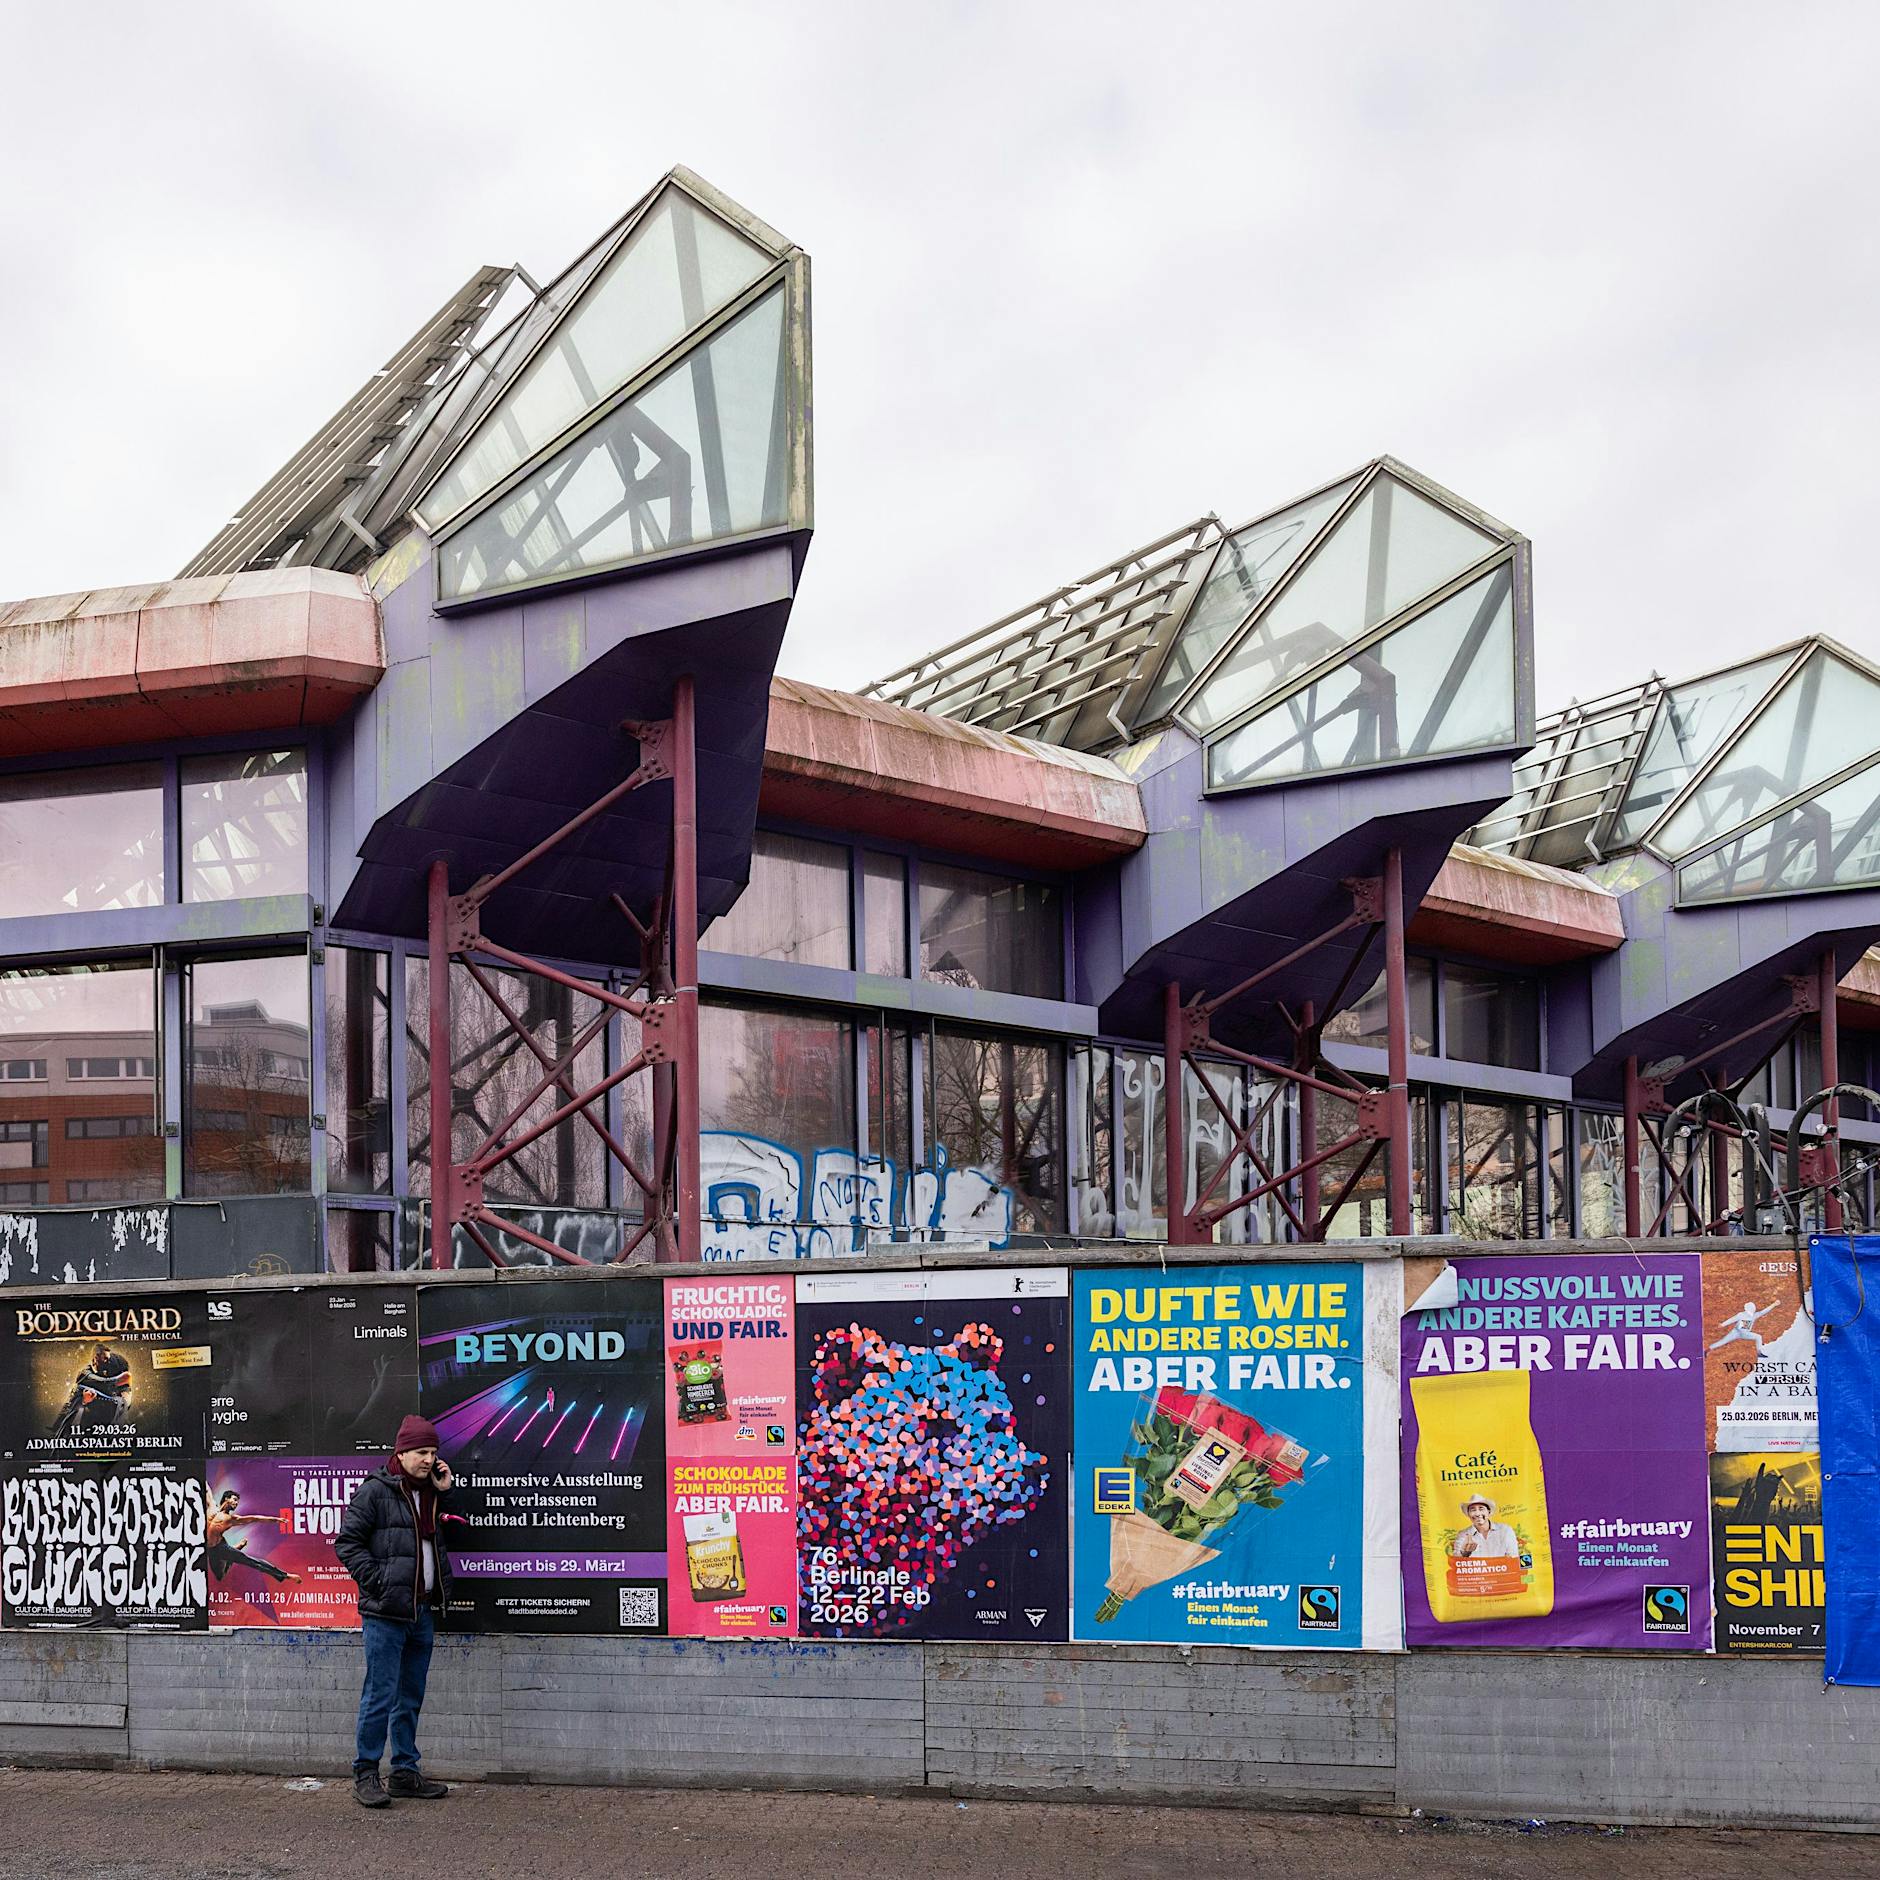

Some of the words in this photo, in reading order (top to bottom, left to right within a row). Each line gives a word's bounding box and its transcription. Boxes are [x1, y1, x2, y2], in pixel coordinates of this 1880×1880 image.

[1759, 1262, 1798, 1273] dEUS
[1621, 1274, 1684, 1298] WIE
[671, 1285, 787, 1306] FRUCHTIG,
[1090, 1285, 1241, 1323] DUFTE
[1250, 1283, 1347, 1319] WIE
[34, 1303, 52, 1311] THE
[384, 1308, 407, 1316] Berghain
[671, 1305, 787, 1321] SCHOKOLADIG.
[16, 1307, 182, 1335] BODYGUARD
[1417, 1306, 1542, 1331] ANDERE
[1547, 1303, 1688, 1329] KAFFEES.
[121, 1333, 139, 1341] THE
[141, 1332, 182, 1341] MUSICAL
[354, 1325, 408, 1339] Liminals
[672, 1321, 723, 1340] UND
[729, 1320, 788, 1339] FAIR.
[1089, 1326, 1221, 1352] ANDERE
[1228, 1324, 1349, 1350] ROSEN.
[455, 1331, 625, 1364] BEYOND
[1416, 1334, 1553, 1373] ABER
[1563, 1333, 1691, 1371] FAIR.
[1088, 1356, 1217, 1392] ABER
[1228, 1354, 1351, 1390] FAIR.
[1722, 1362, 1789, 1373] WORST
[1756, 1375, 1810, 1384] VERSUS
[1739, 1386, 1758, 1397] IN
[1767, 1385, 1780, 1397] A
[732, 1395, 787, 1405] #fairbruary
[1721, 1411, 1770, 1421] 25.03.2026
[1772, 1411, 1802, 1422] BERLIN,
[739, 1426, 754, 1435] dm
[26, 1437, 134, 1450] ADMIRALSPALAST
[136, 1436, 183, 1448] BERLIN
[1455, 1449, 1498, 1468] Café
[674, 1466, 787, 1481] SCHOKOLADE
[1440, 1463, 1519, 1482] Intención
[471, 1473, 550, 1488] immersive
[552, 1473, 643, 1490] Ausstellung
[674, 1483, 704, 1495] ZUM
[706, 1480, 789, 1495] FRÜHSTÜCK.
[486, 1493, 505, 1507] im
[510, 1493, 597, 1507] verlassenen
[674, 1496, 732, 1513] ABER
[735, 1496, 790, 1513] FAIR.
[466, 1513, 527, 1527] tadtbad
[531, 1512, 626, 1530] Lichtenberg
[1560, 1518, 1693, 1539] #fairbruary
[695, 1540, 730, 1558] Krunchy
[1578, 1542, 1614, 1553] Einen
[1616, 1542, 1659, 1553] Monat
[696, 1555, 732, 1564] CHOCOLATE
[810, 1546, 843, 1565] 76.
[1455, 1559, 1487, 1567] CREMA
[1578, 1555, 1602, 1567] fair
[1603, 1555, 1670, 1567] einkaufen
[460, 1558, 532, 1574] Verlängert
[535, 1559, 557, 1572] bis
[560, 1560, 582, 1572] 29.
[585, 1559, 626, 1572] März!
[702, 1561, 728, 1569] CHUNKS
[1456, 1565, 1507, 1574] AROMATICO
[2, 1543, 103, 1609] GLÜCK
[102, 1543, 208, 1609] GLÜCK
[810, 1566, 910, 1585] Berlinale
[890, 1586, 931, 1605] Feb
[1172, 1581, 1290, 1601] #fairbruary
[1725, 1568, 1825, 1608] SHI
[56, 1606, 92, 1614] DAUGHTER
[508, 1607, 578, 1616] stadtbadreloaded.de
[713, 1604, 766, 1614] #fairbruary
[810, 1605, 869, 1623] 2026
[975, 1610, 1007, 1619] ARMANI
[1187, 1602, 1219, 1613] Einen
[1222, 1602, 1259, 1614] Monat
[1187, 1615, 1208, 1625] fair
[1210, 1615, 1268, 1627] einkaufen
[1301, 1620, 1338, 1628] FAIRTRADE
[1646, 1623, 1687, 1631] FAIRTRADE
[1728, 1623, 1803, 1636] November
[1811, 1624, 1821, 1635] 7
